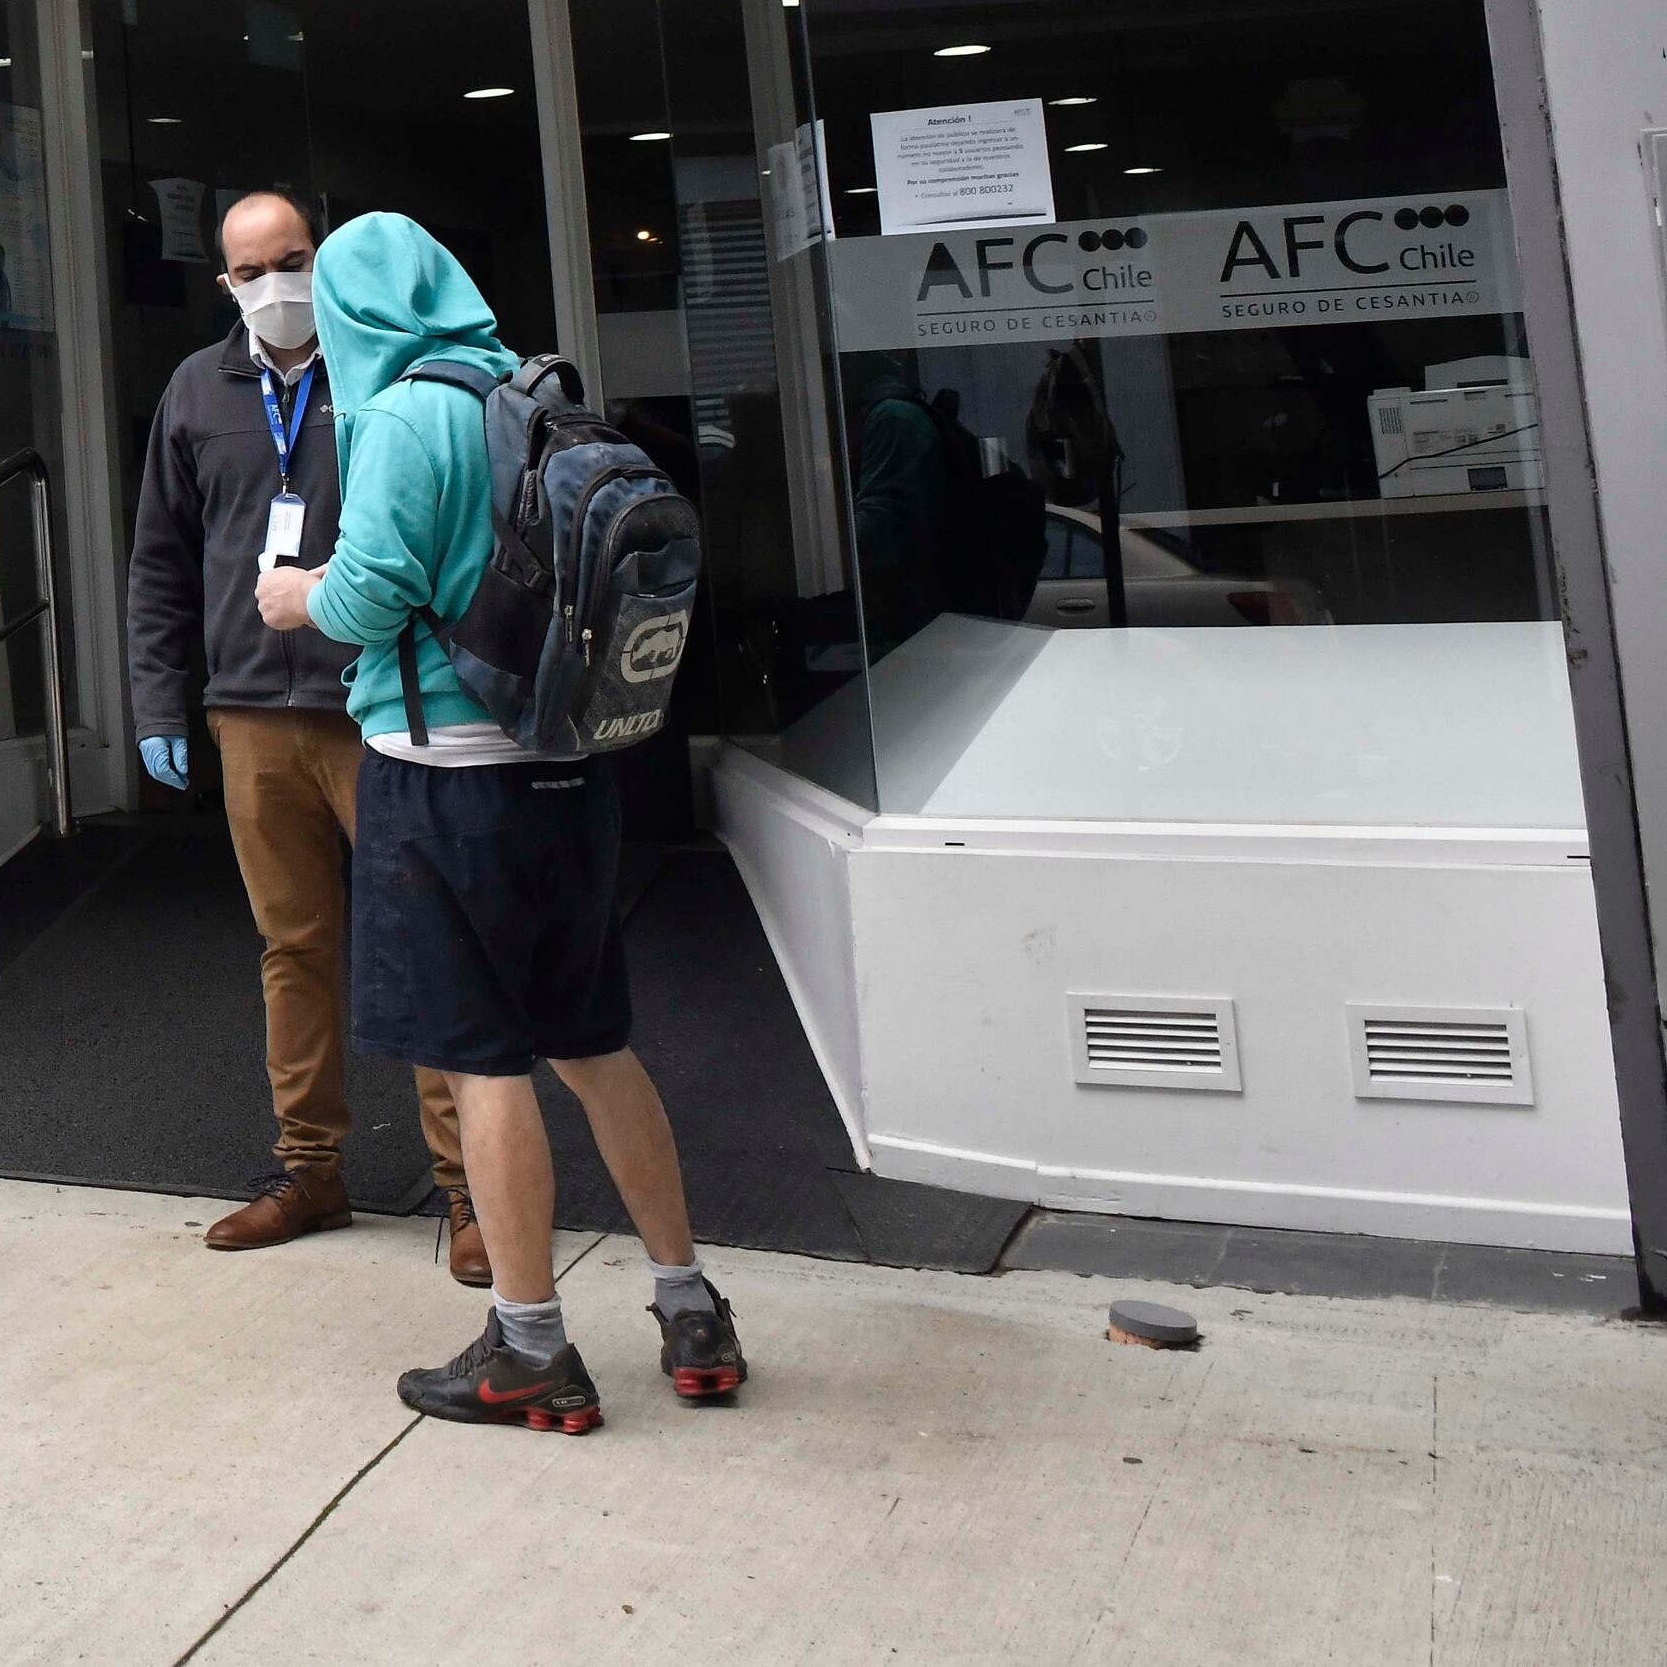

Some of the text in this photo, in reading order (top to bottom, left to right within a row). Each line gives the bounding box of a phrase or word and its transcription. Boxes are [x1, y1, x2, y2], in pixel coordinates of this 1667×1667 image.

[927, 115, 966, 126] Atención
[959, 186, 977, 196] 800
[979, 184, 1014, 195] 800232
[1219, 209, 1476, 283] AFC Chile
[916, 232, 1153, 301] AFC Chile
[1222, 299, 1306, 319] SEGURO
[1314, 296, 1345, 314] DE
[917, 317, 996, 337] SEGURO
[1005, 315, 1033, 333] DE
